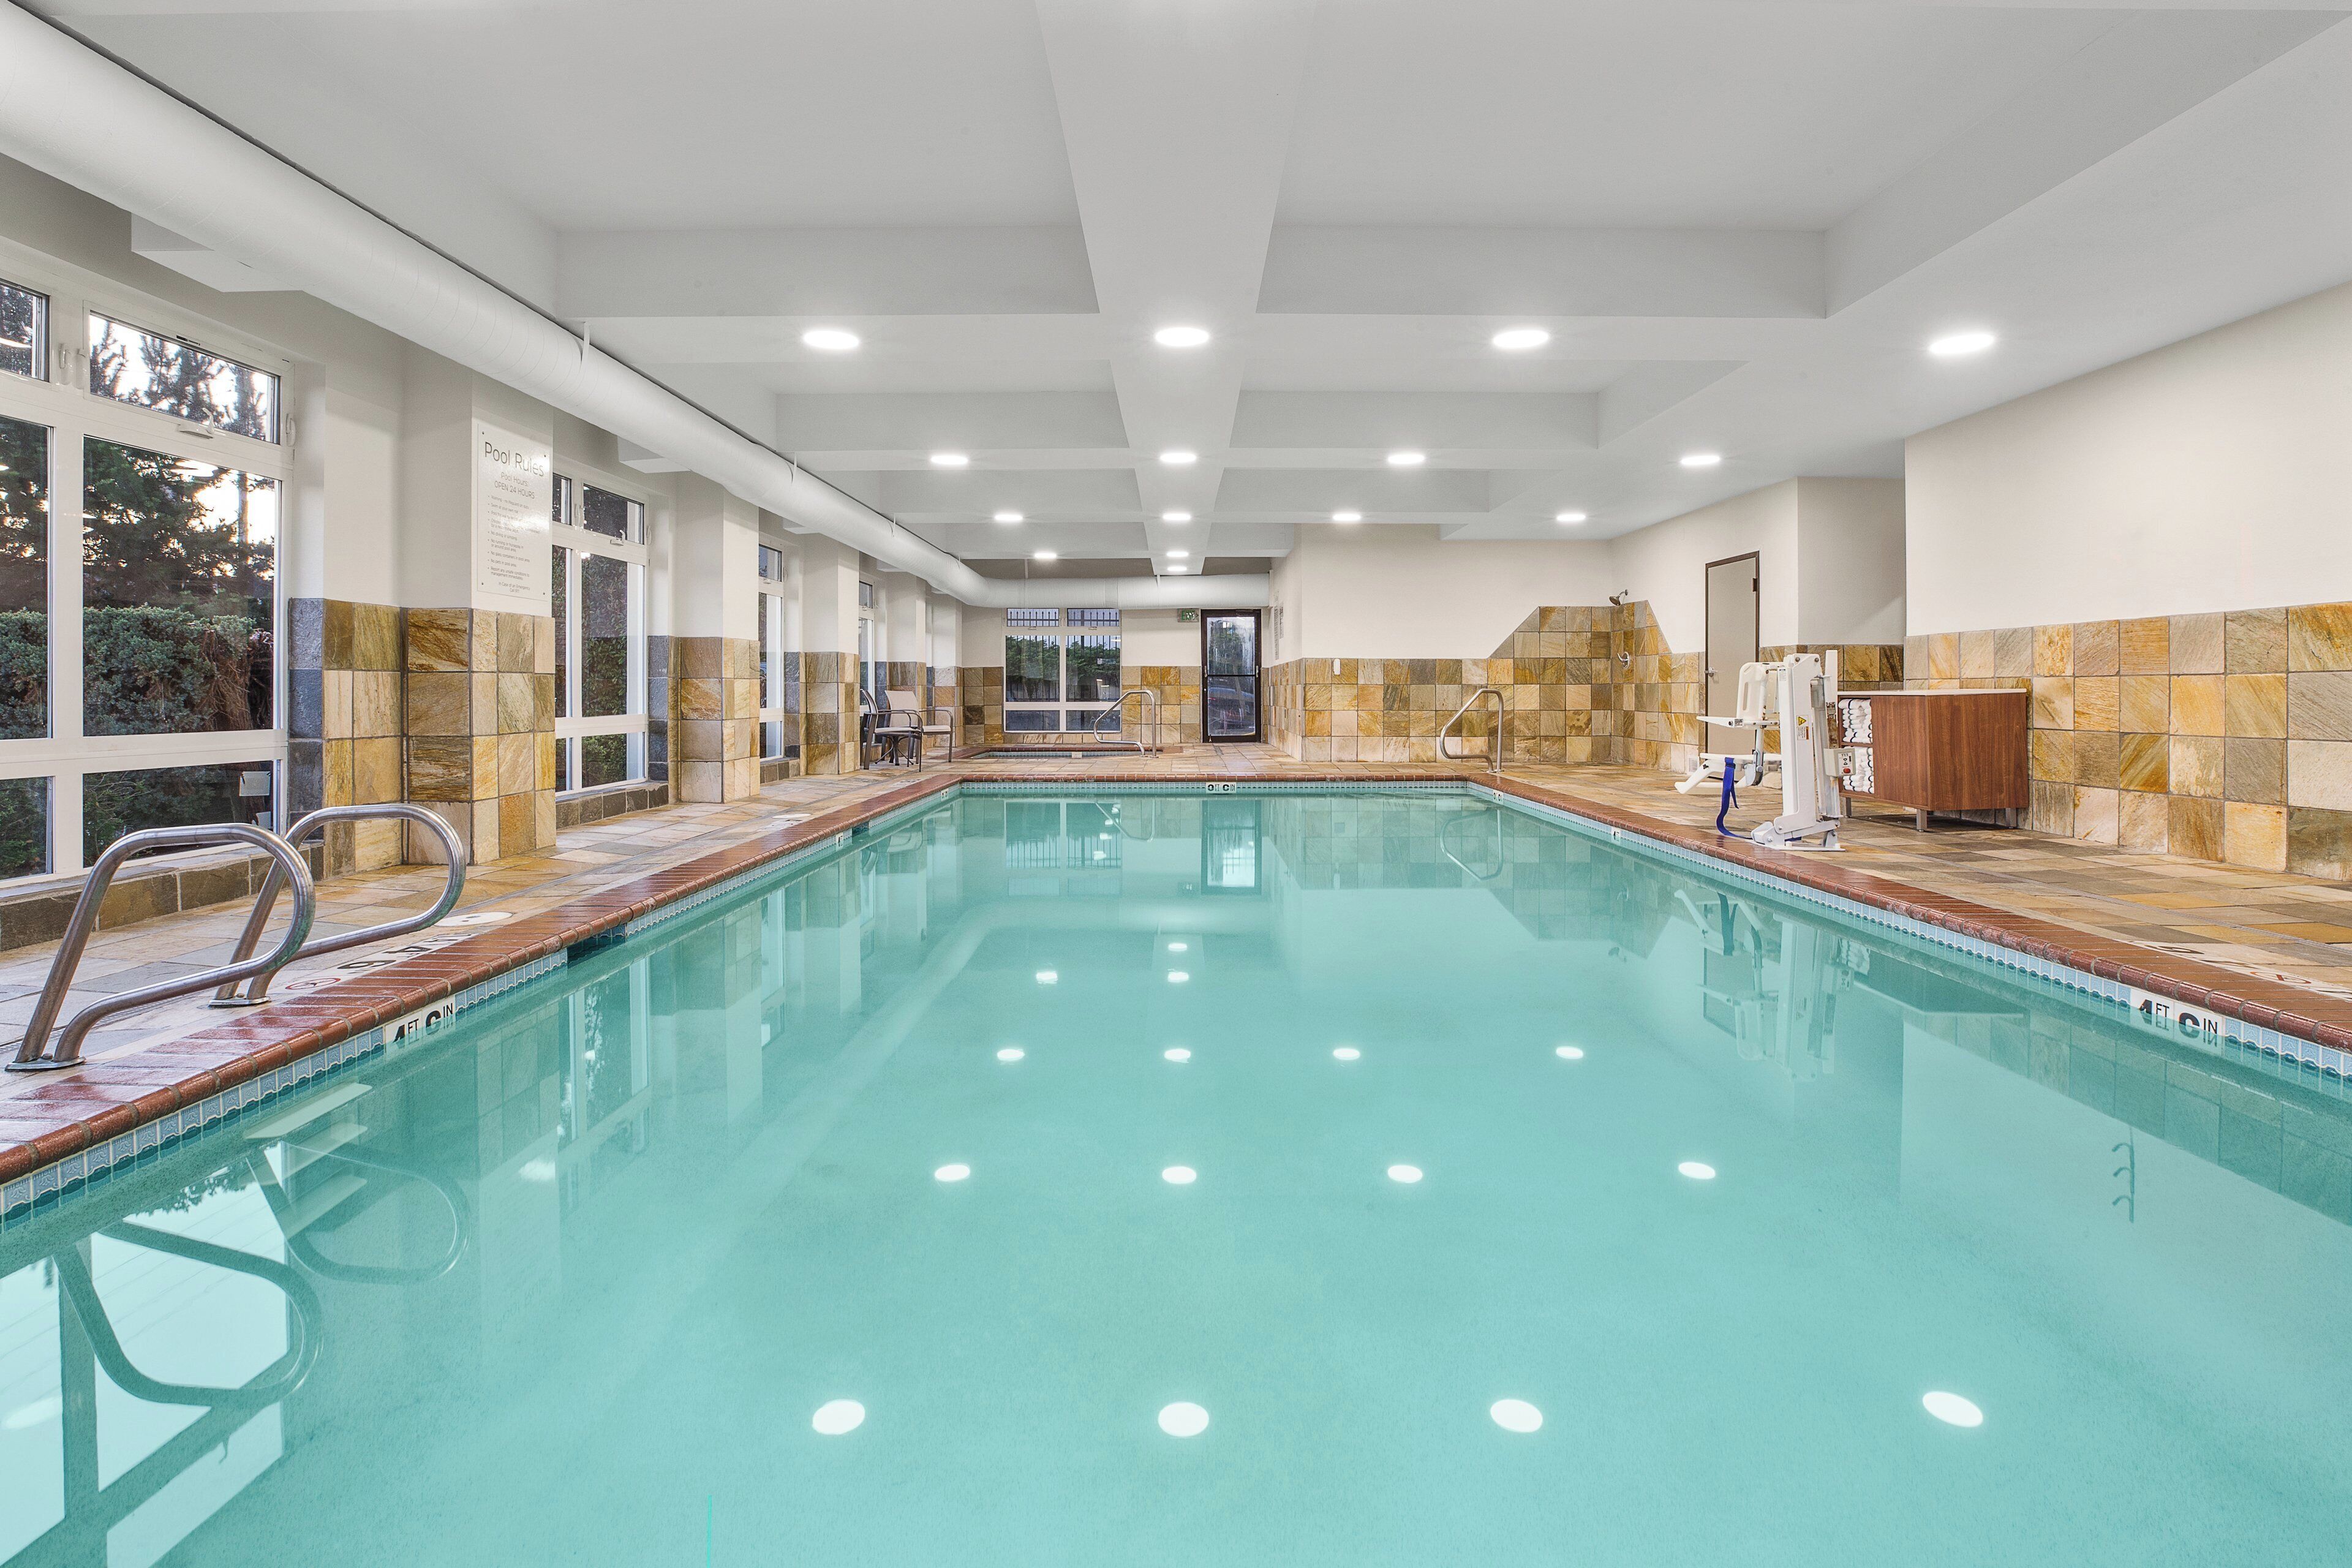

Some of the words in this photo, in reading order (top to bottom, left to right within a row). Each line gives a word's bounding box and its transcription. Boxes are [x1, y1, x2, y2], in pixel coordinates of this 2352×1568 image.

[484, 441, 510, 466] Pool
[515, 452, 544, 477] Rules
[500, 472, 512, 481] Pool
[494, 480, 508, 491] OPEN
[518, 488, 535, 499] HOURS
